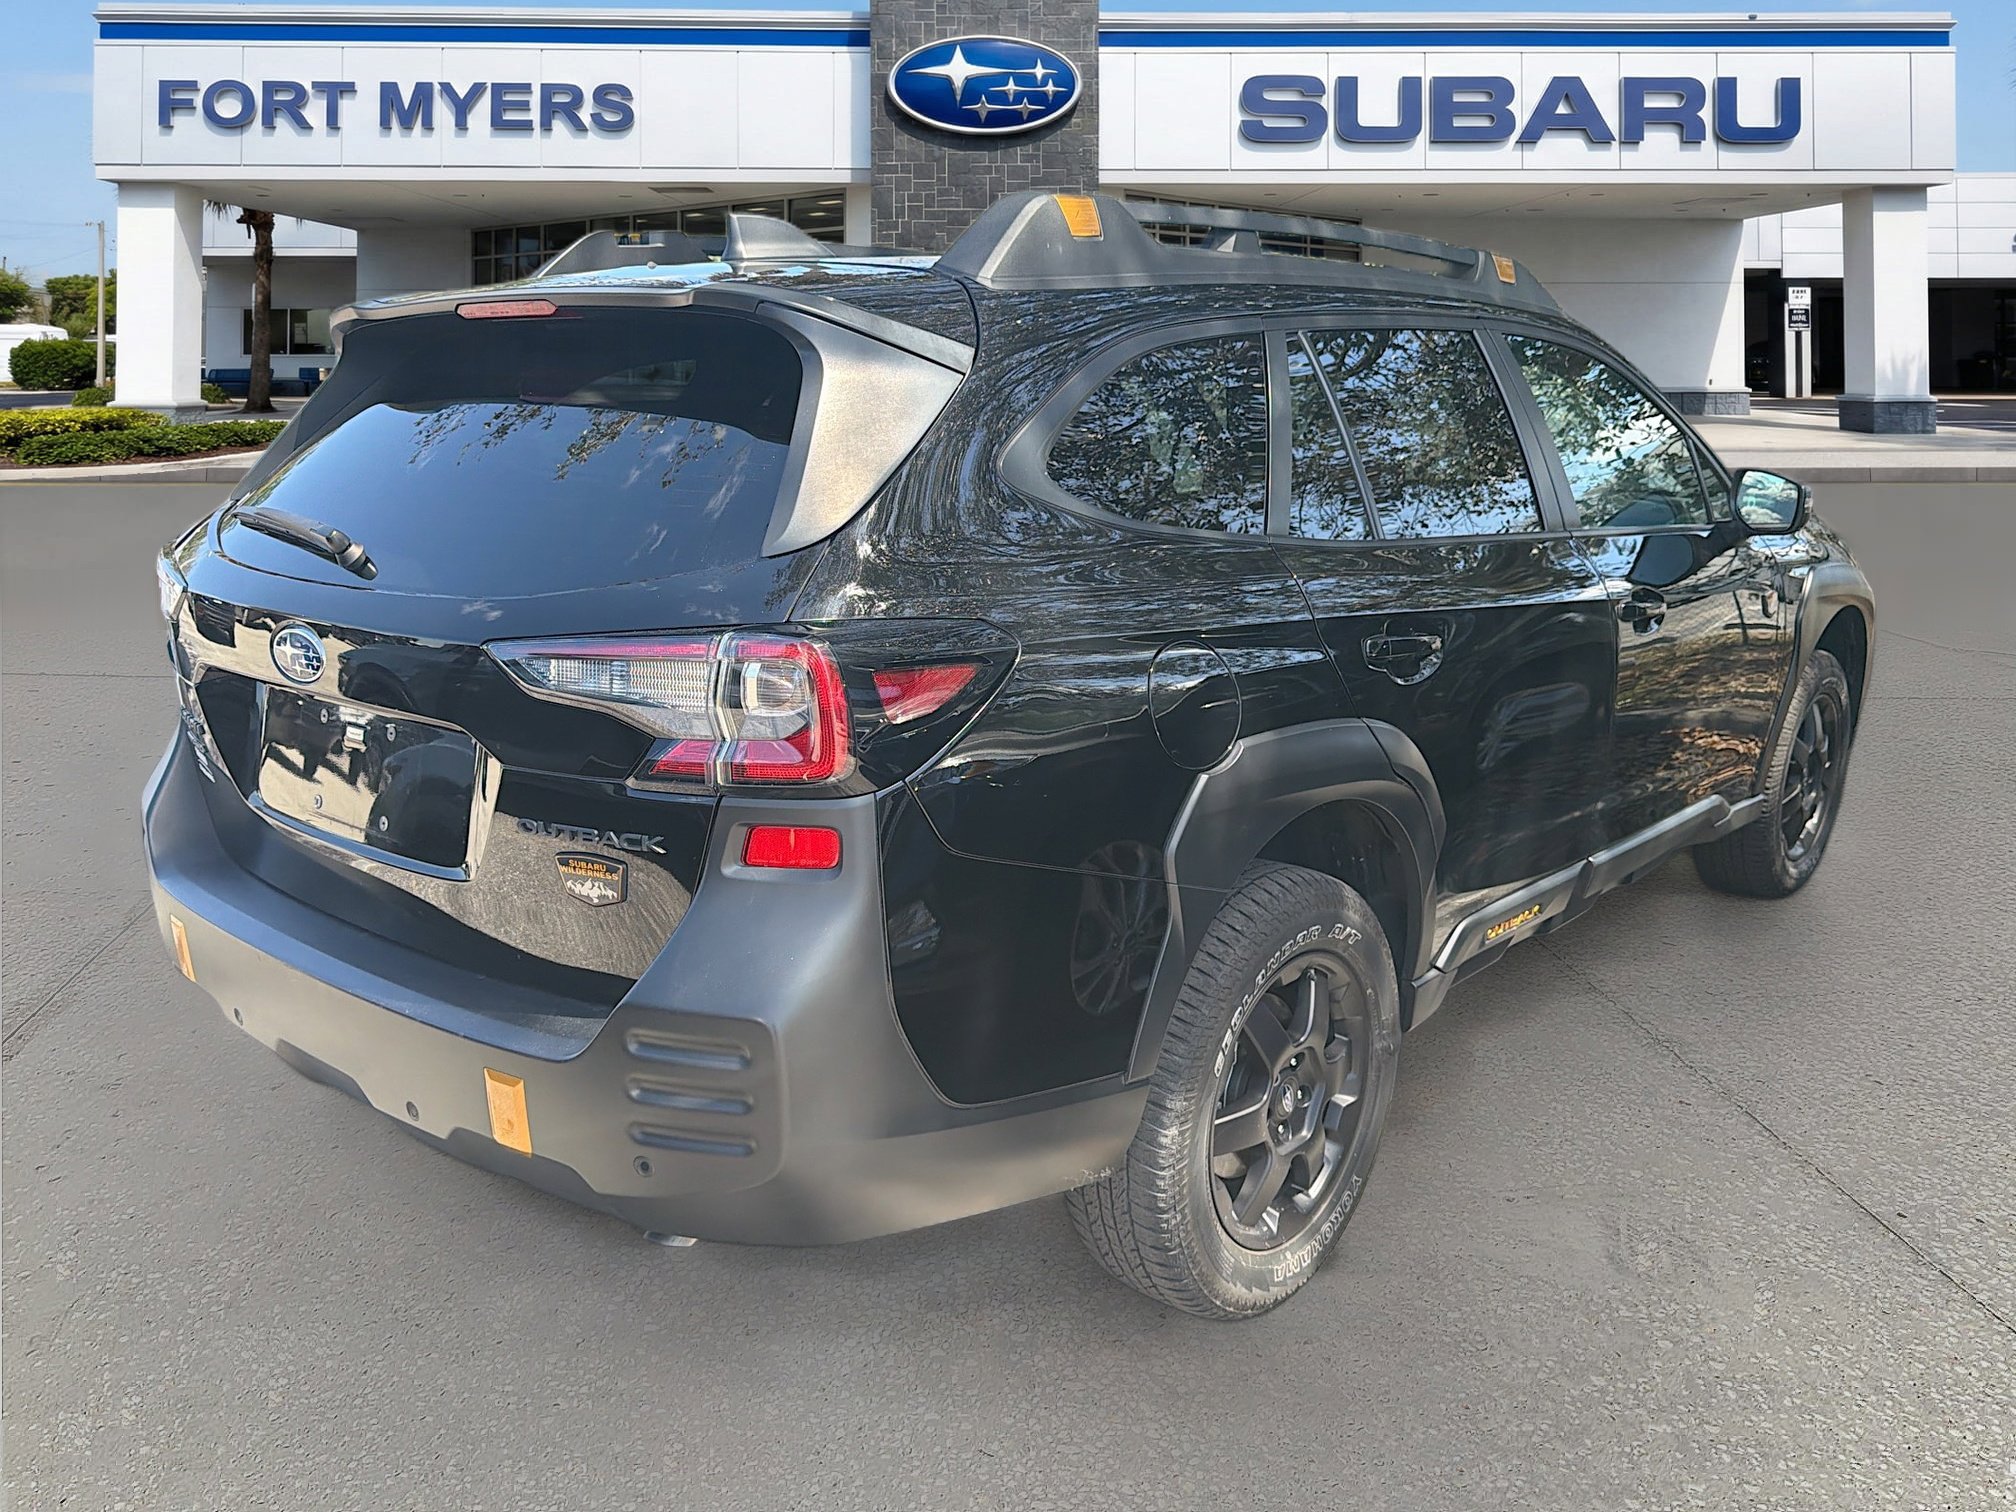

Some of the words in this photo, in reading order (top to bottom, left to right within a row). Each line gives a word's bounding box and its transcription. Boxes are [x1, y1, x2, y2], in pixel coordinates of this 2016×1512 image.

[157, 79, 358, 131] FORT
[379, 81, 635, 132] MYERS
[1239, 74, 1802, 146] SUBARU
[516, 817, 668, 855] OUTBACK
[559, 864, 619, 881] WILDERNESS
[568, 858, 607, 872] SUBARU
[1327, 923, 1362, 945] A/T
[1273, 1174, 1362, 1282] YOKOHAMA
